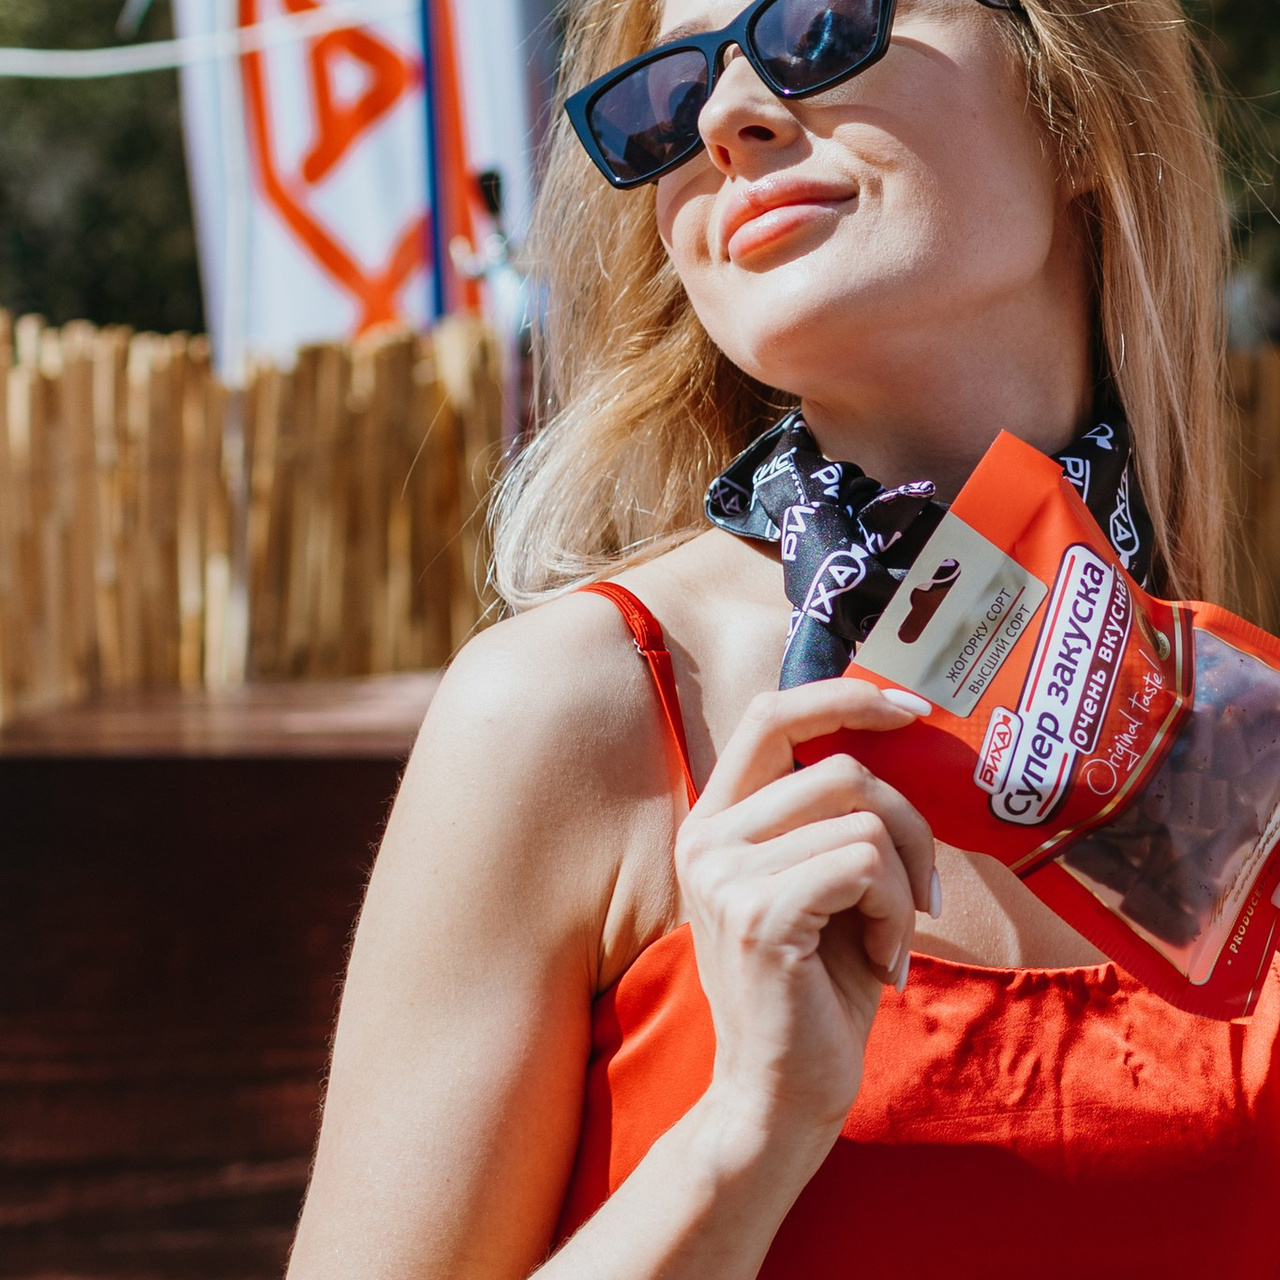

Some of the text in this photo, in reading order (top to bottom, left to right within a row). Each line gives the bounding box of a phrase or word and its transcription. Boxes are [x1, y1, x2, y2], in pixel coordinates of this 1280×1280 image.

[945, 587, 1011, 683] ЖОГОРКУ СОРТ
[968, 603, 1031, 695] ВЫСШИЙ СОРТ
[1003, 561, 1105, 816] Супер закуска
[1071, 669, 1107, 746] очень
[982, 725, 1012, 787] РИХА
[1080, 708, 1143, 796] Original
